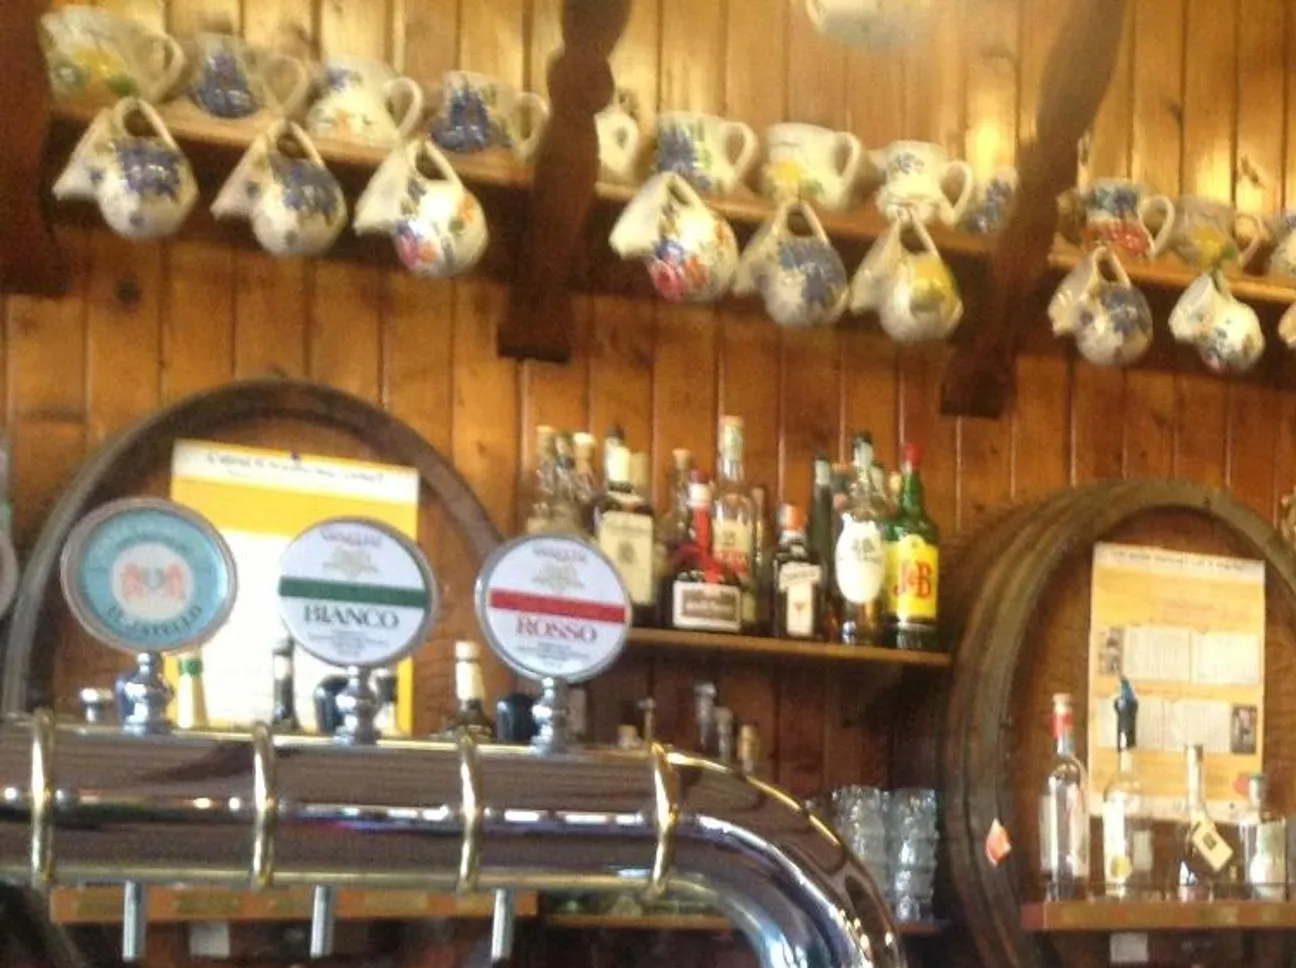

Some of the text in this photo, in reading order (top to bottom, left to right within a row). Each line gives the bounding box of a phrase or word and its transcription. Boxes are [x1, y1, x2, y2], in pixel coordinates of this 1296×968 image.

[891, 560, 933, 600] J&B
[303, 603, 400, 629] BIANCO
[515, 616, 598, 643] ROSSO
